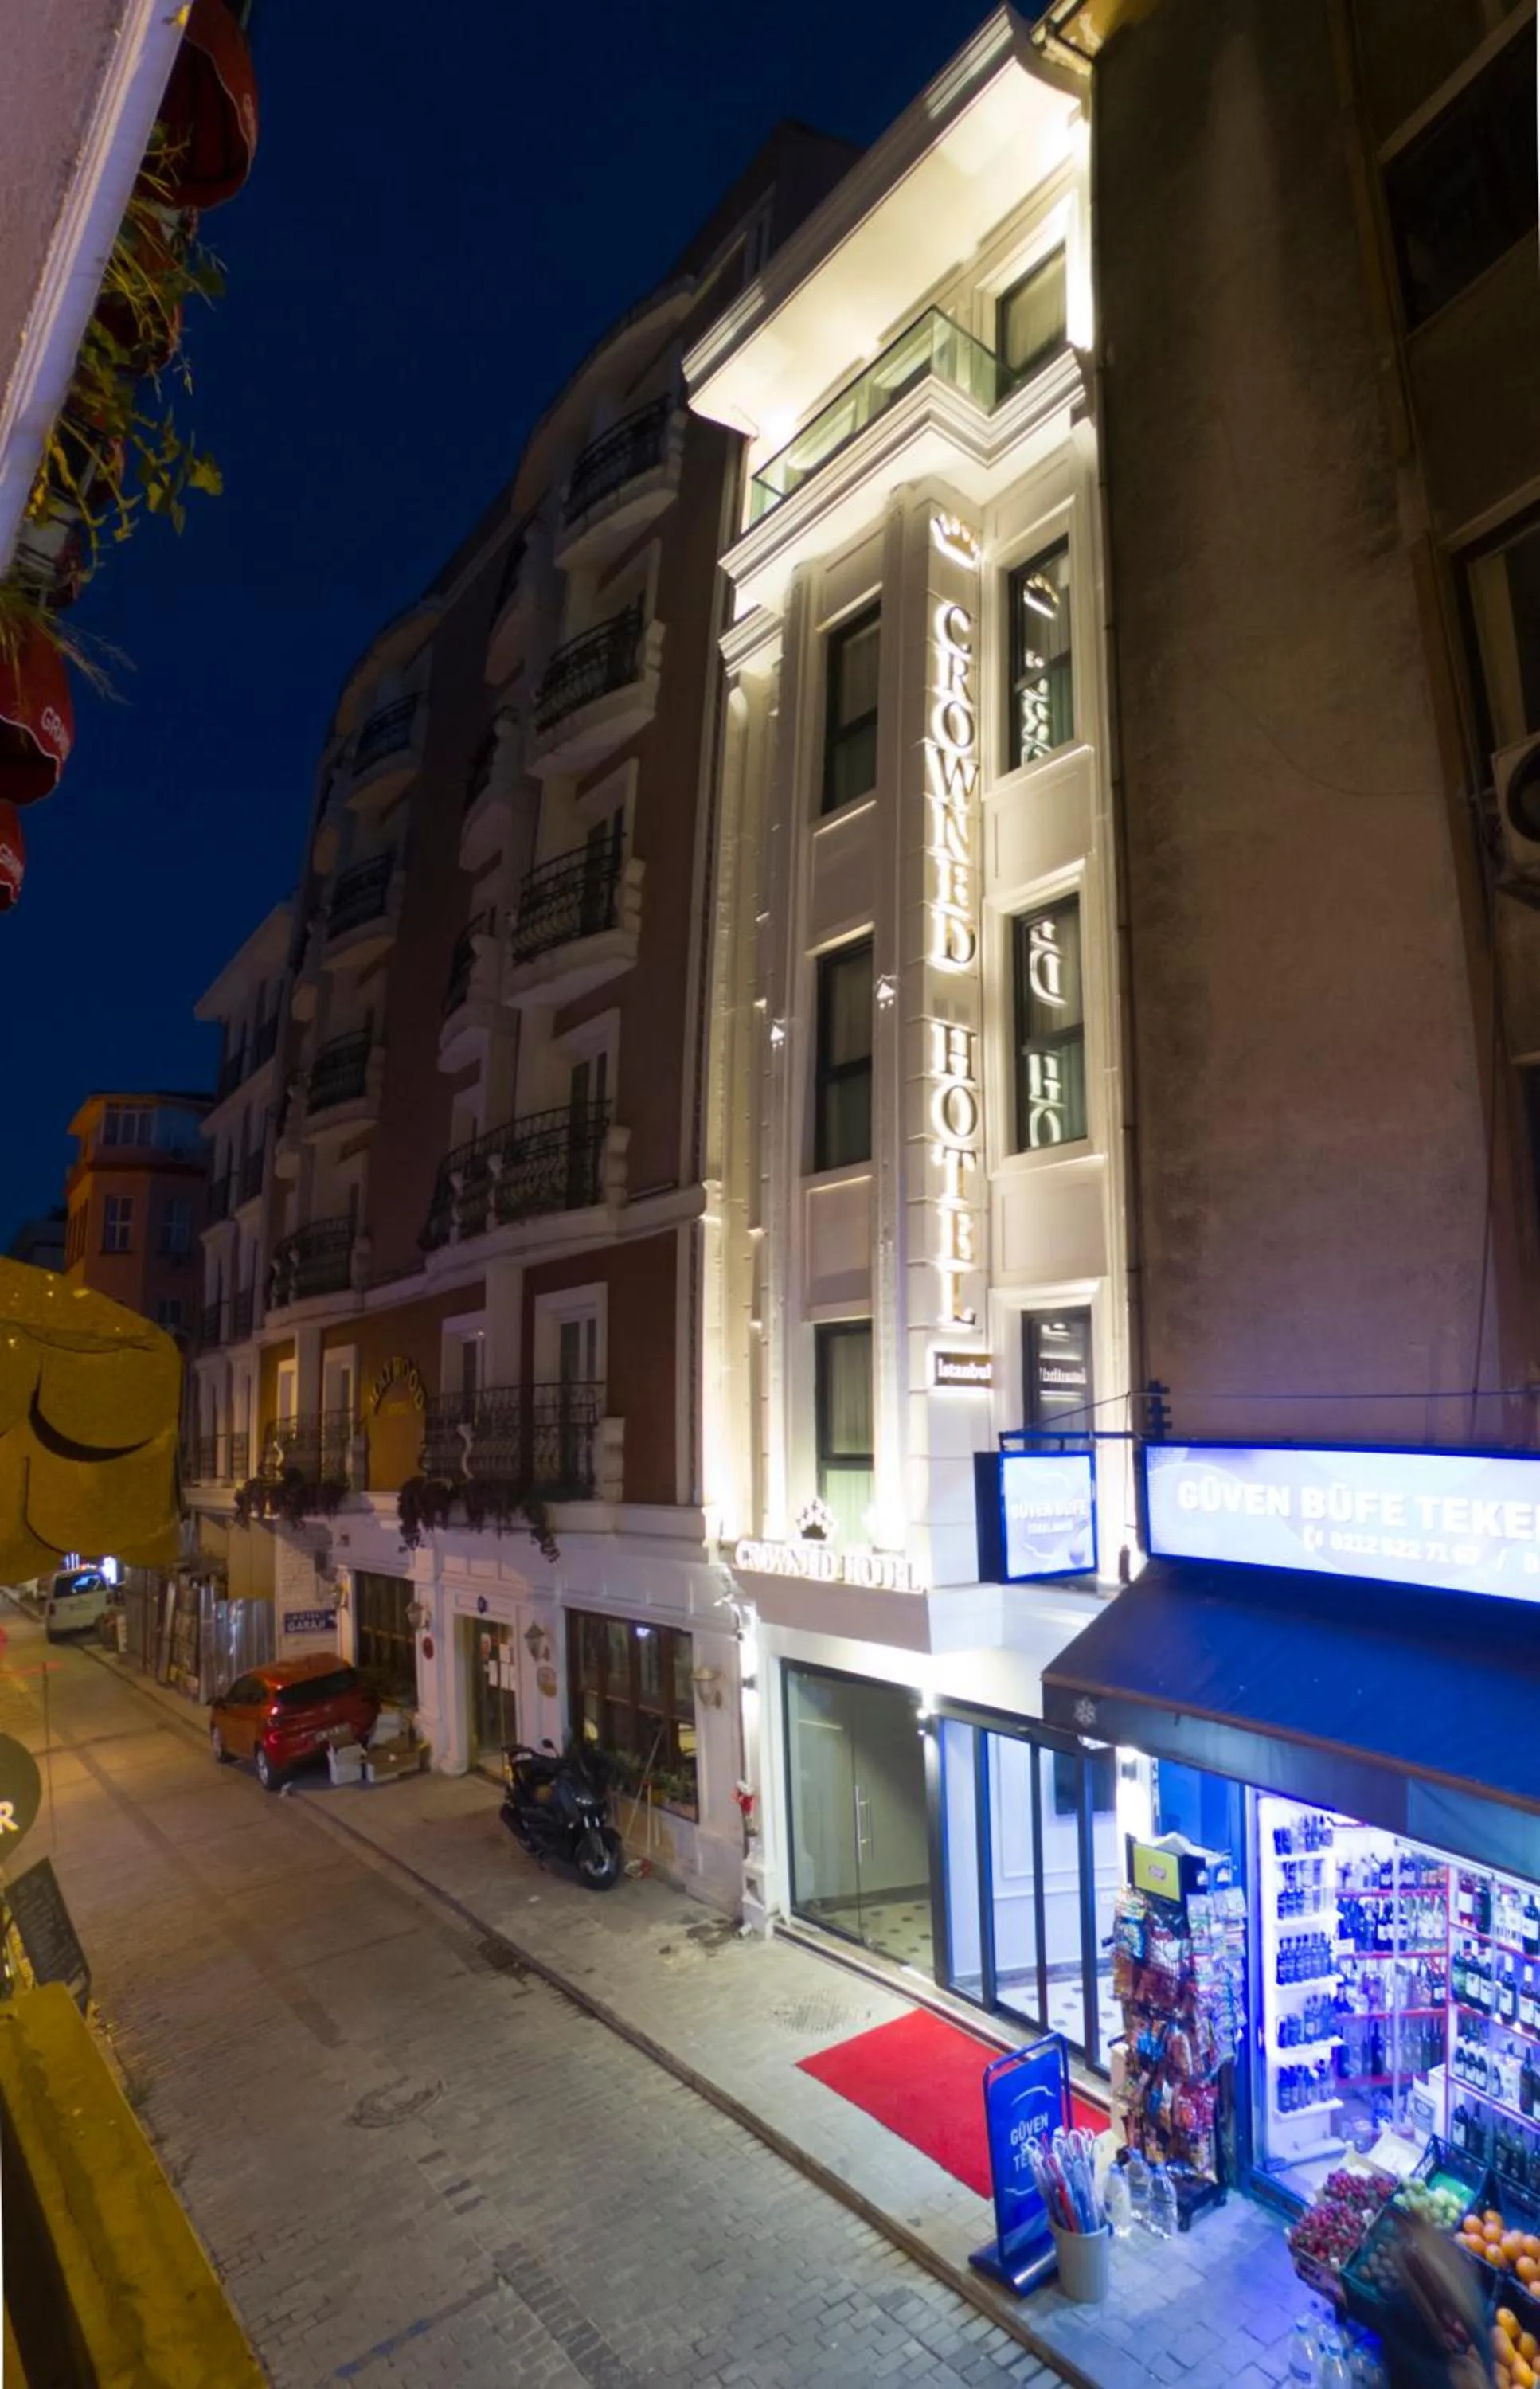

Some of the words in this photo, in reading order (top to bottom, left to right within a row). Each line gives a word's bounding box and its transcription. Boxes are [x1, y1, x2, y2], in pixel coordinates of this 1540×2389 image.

[926, 604, 979, 970] CROWNED
[932, 1022, 978, 1328] HOTEL
[1178, 1475, 1291, 1517] GÜVEN
[1301, 1481, 1406, 1528] BÜFE
[1417, 1496, 1540, 1541] TEKE
[839, 1554, 924, 1593] HOTEL
[1010, 2111, 1049, 2147] GÜVEN
